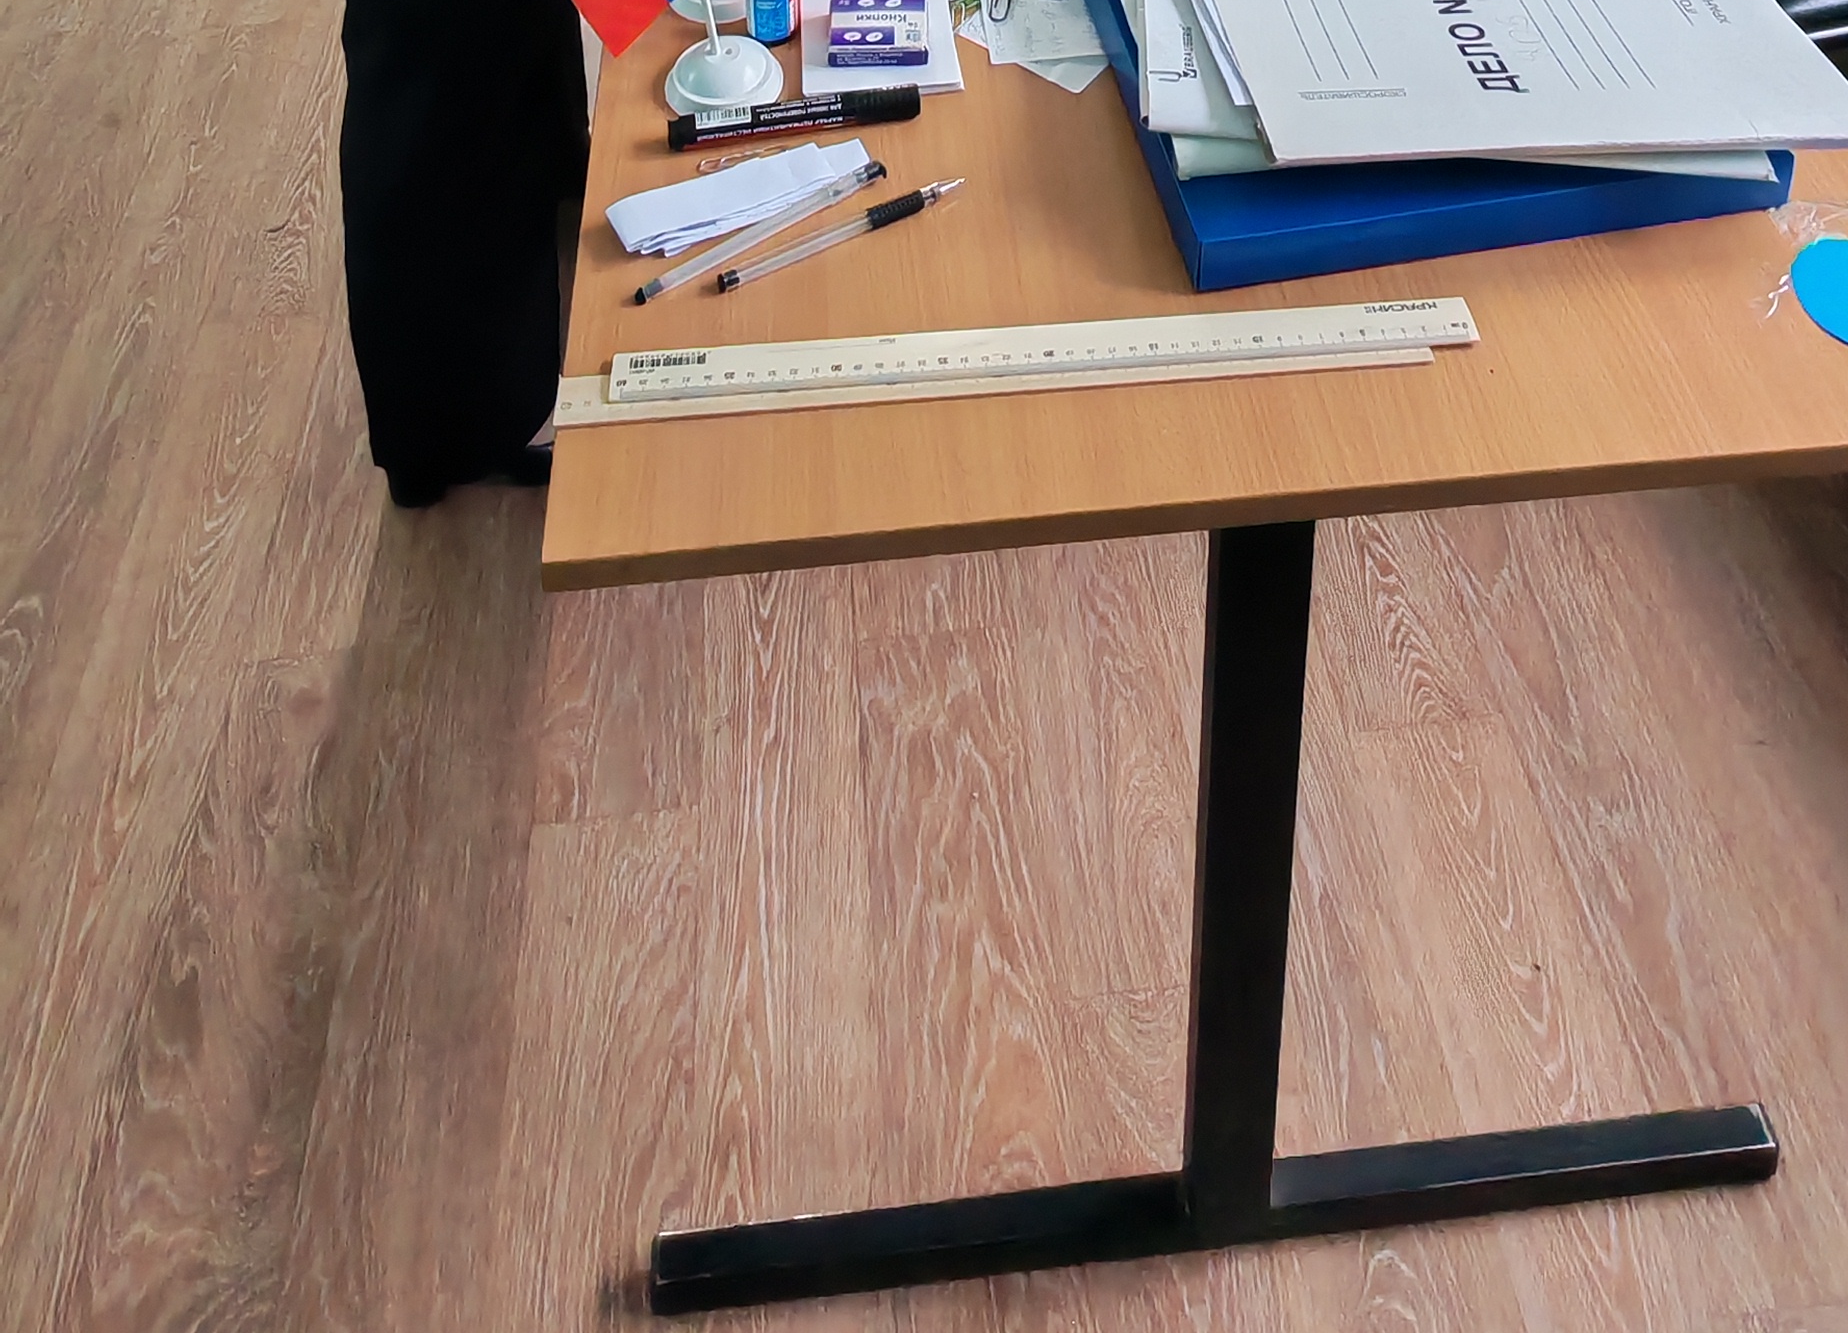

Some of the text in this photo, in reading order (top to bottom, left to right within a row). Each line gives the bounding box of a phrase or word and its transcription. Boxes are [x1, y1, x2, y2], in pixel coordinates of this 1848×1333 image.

[856, 13, 907, 23] Кнопки
[1447, 22, 1531, 94] ДЕЛО
[1371, 301, 1438, 314] КРАСИН
